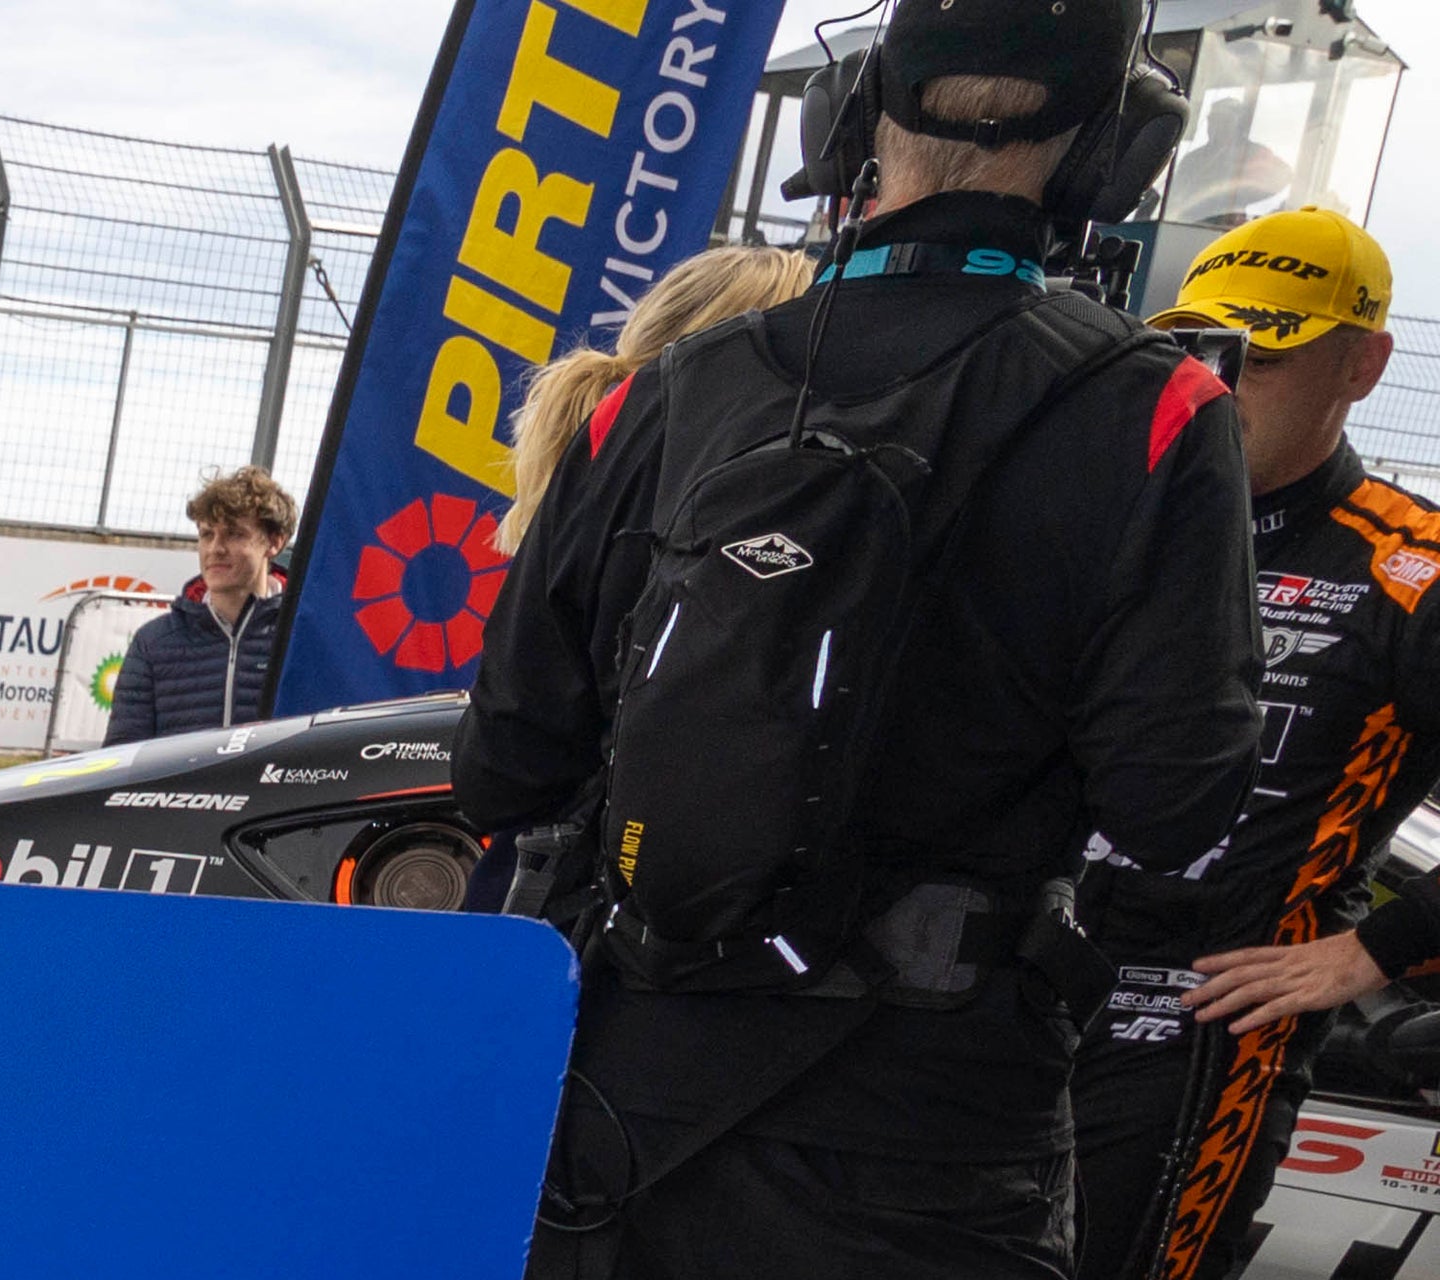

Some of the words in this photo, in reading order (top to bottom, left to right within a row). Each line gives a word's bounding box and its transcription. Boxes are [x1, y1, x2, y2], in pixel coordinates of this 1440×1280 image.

[1385, 553, 1437, 581] OMP
[1312, 579, 1370, 594] TOYOTA
[1305, 589, 1360, 602] GAZOO
[1258, 606, 1331, 625] Australia
[397, 742, 441, 753] THINK
[284, 769, 349, 782] KANGAN
[104, 790, 250, 812] SIGNZONE
[620, 820, 645, 857] FLOW
[1402, 1170, 1440, 1185] SUP
